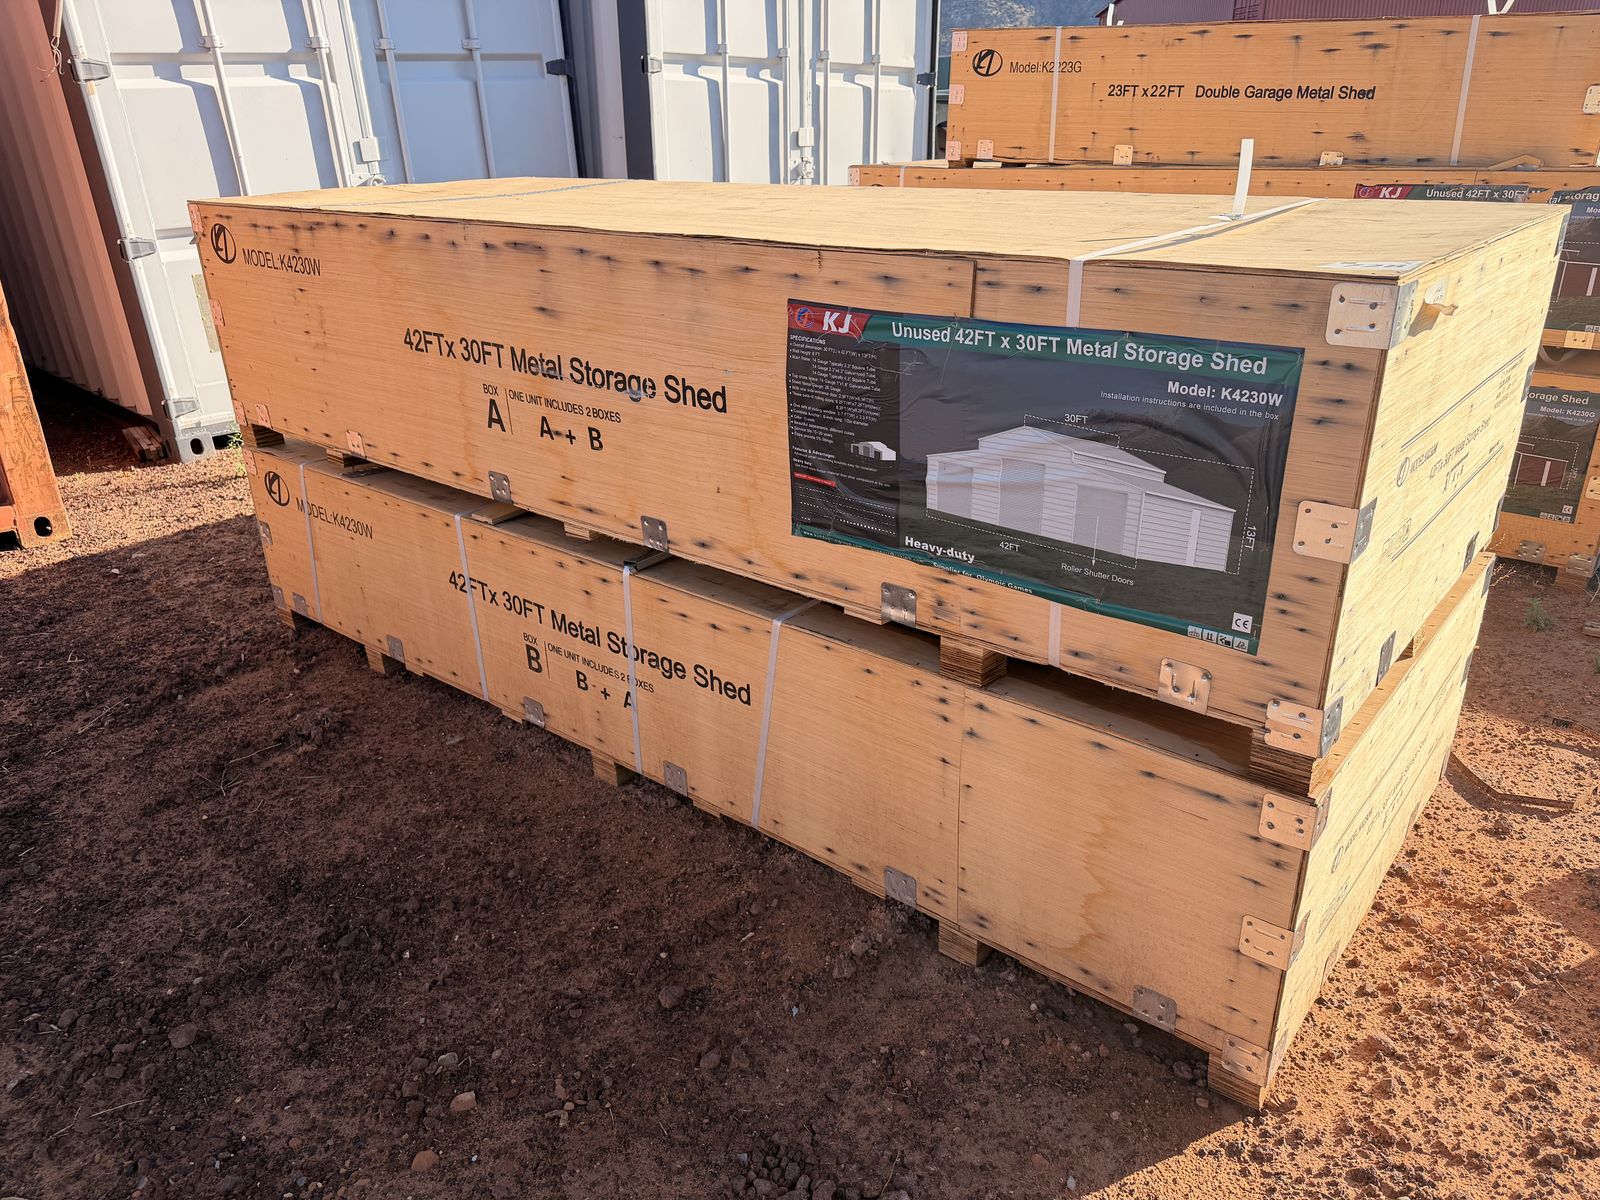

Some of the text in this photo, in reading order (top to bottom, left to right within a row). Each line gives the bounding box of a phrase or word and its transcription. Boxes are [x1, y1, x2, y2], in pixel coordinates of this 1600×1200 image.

[1108, 84, 1139, 97] 23FT
[1195, 85, 1240, 98] Double
[1244, 85, 1293, 101] Garage
[1296, 85, 1335, 99] Metal
[1338, 85, 1376, 100] Shed
[1379, 187, 1402, 199] KJ
[1426, 188, 1464, 199] Unused
[1465, 189, 1491, 198] 42FT
[242, 247, 321, 277] MODEL:K4230W
[822, 310, 852, 334] KJ
[892, 321, 1268, 375] Unused 42FT x 30FT Metal Storage Shed
[459, 337, 504, 369] 30FT
[510, 346, 563, 381] Metal
[569, 357, 656, 402] Storage
[664, 374, 727, 414] Shed
[483, 383, 499, 398] BOX
[1167, 380, 1284, 407] Model: K4230W
[1529, 392, 1589, 405] orage Shed
[487, 398, 507, 433] A
[508, 389, 525, 403] ONE
[526, 393, 543, 407] UNIT
[544, 396, 584, 416] INCLUDES
[592, 407, 621, 423] BOXES
[1064, 413, 1088, 425] 30FT
[1100, 390, 1279, 421] Installation instructions are included in the box
[540, 415, 555, 440] A
[588, 426, 604, 451] B
[296, 497, 373, 540] MODEL:K4230W
[904, 535, 975, 563] Heavy-duty
[999, 541, 1020, 552] 42FT
[1246, 525, 1257, 552] 13FT
[976, 574, 1006, 587] Olympic
[1007, 582, 1033, 594] Games
[1061, 562, 1134, 587] Roller Shutter Doors
[502, 590, 545, 625] 30FT
[551, 609, 600, 648] Metal
[607, 631, 687, 680] Storage
[693, 663, 751, 707] Shed
[523, 632, 538, 646] BOX
[525, 644, 543, 674] B
[547, 643, 563, 657] ONE
[563, 648, 581, 664] UNIT
[581, 654, 620, 680] INCLUDES
[620, 672, 626, 682] 2
[576, 669, 589, 692] B
